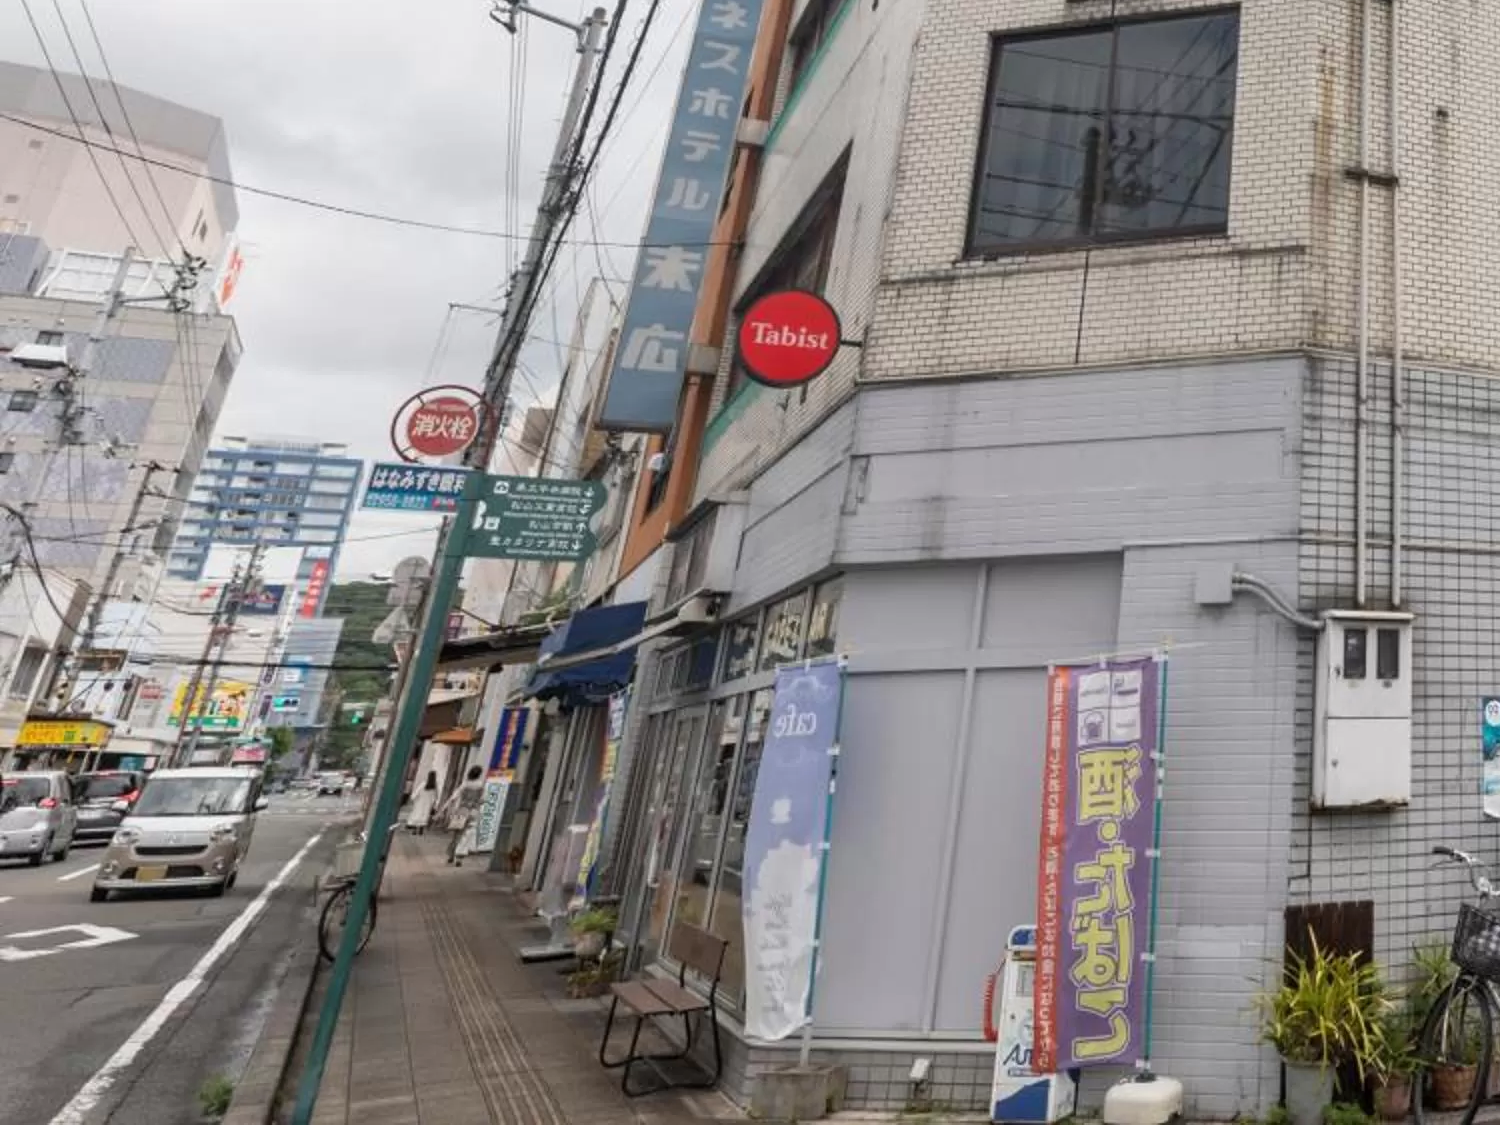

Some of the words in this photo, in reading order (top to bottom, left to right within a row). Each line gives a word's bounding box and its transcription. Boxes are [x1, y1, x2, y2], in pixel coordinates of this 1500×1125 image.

[751, 321, 829, 350] Tabist
[411, 413, 473, 440] 消火栓
